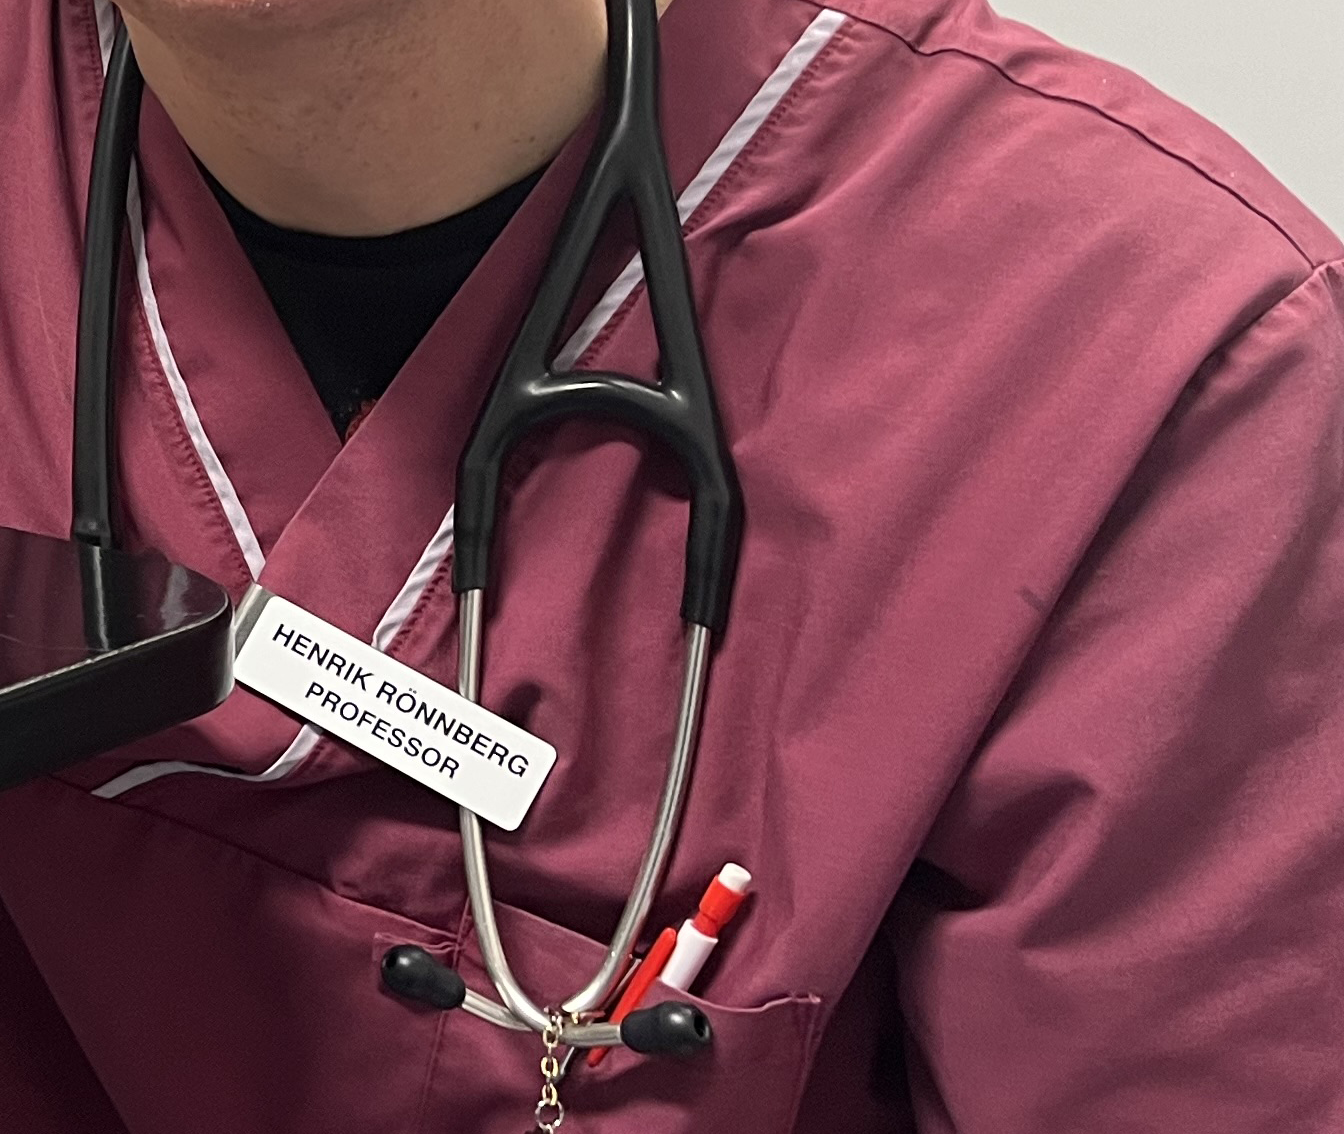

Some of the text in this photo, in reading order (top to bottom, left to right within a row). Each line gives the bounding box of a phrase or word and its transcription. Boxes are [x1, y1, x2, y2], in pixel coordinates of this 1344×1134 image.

[272, 623, 530, 778] HENRIK RÖNNBERG
[304, 681, 461, 779] PROFESSOR
